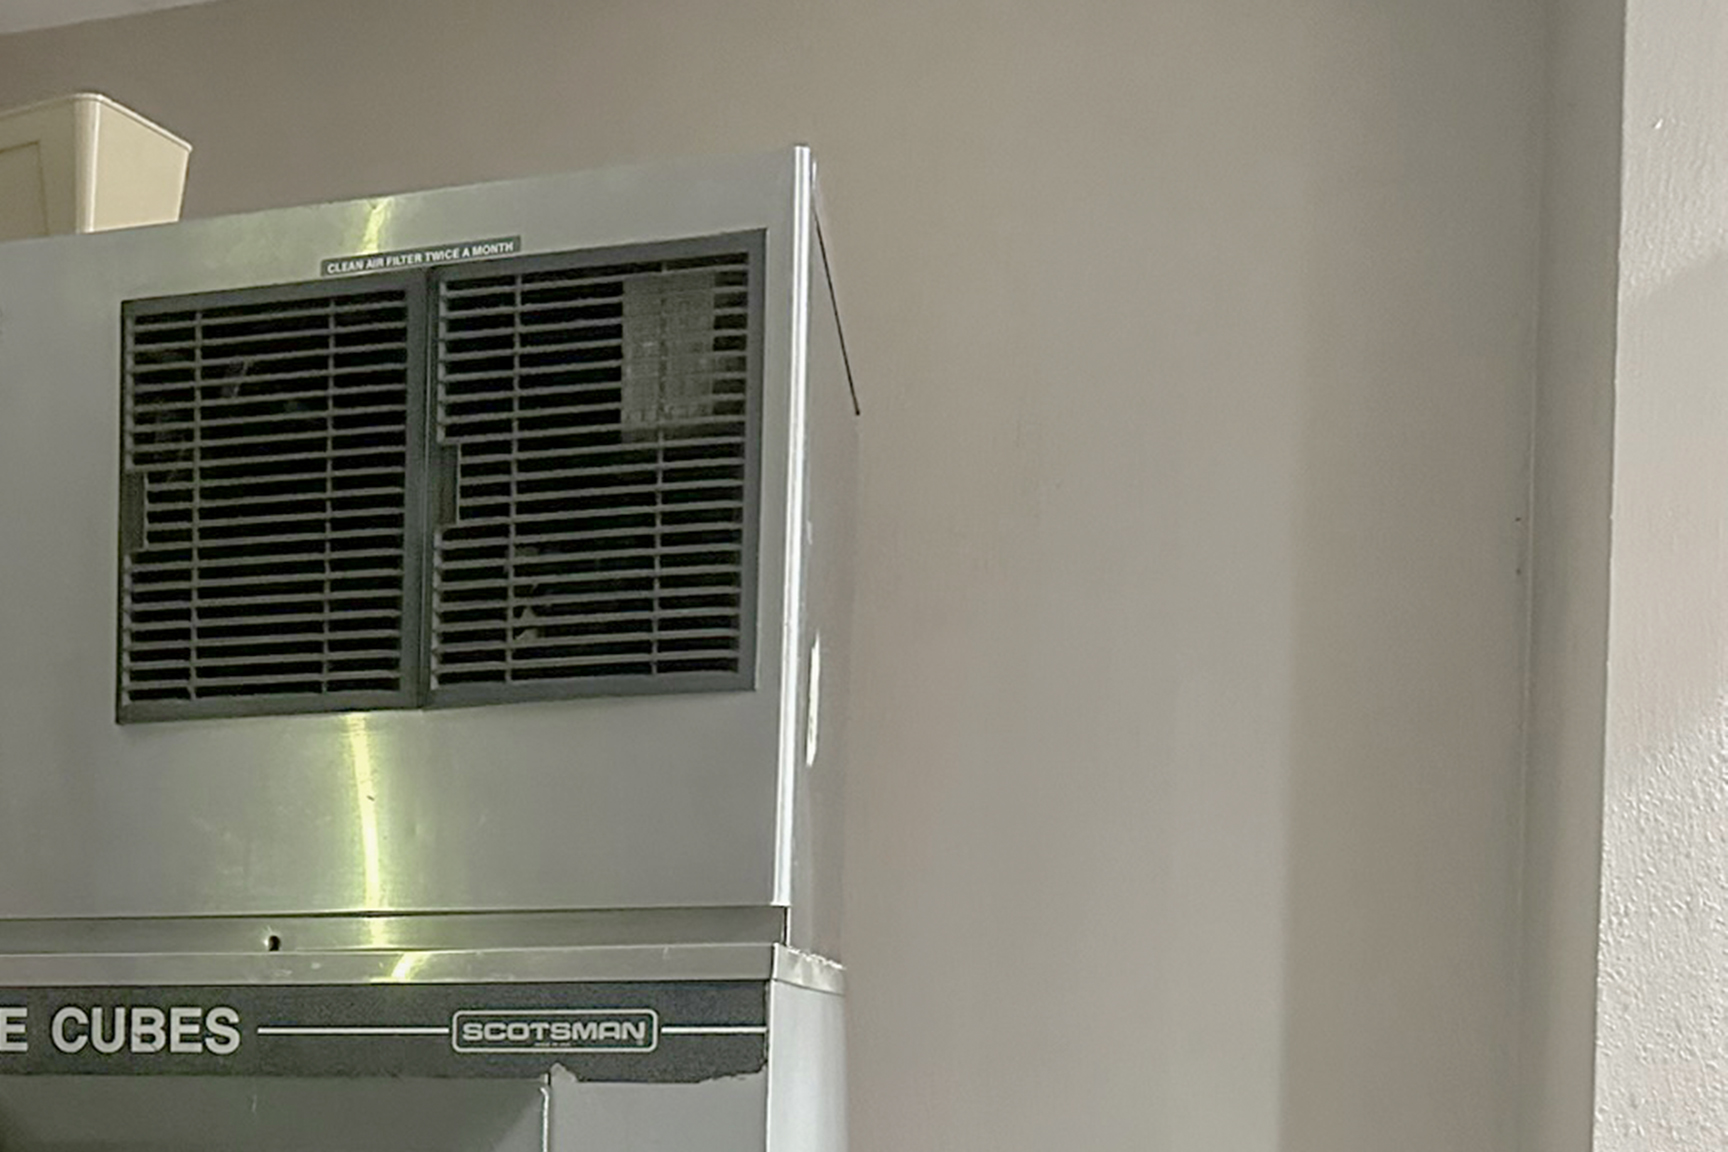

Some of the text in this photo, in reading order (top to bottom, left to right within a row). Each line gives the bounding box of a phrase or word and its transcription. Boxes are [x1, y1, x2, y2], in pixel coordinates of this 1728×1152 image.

[327, 242, 513, 273] CLEAN AIR FILTER TWICE A MONTH
[50, 1005, 241, 1054] CUBES
[463, 1021, 646, 1041] SCOTSMAN
